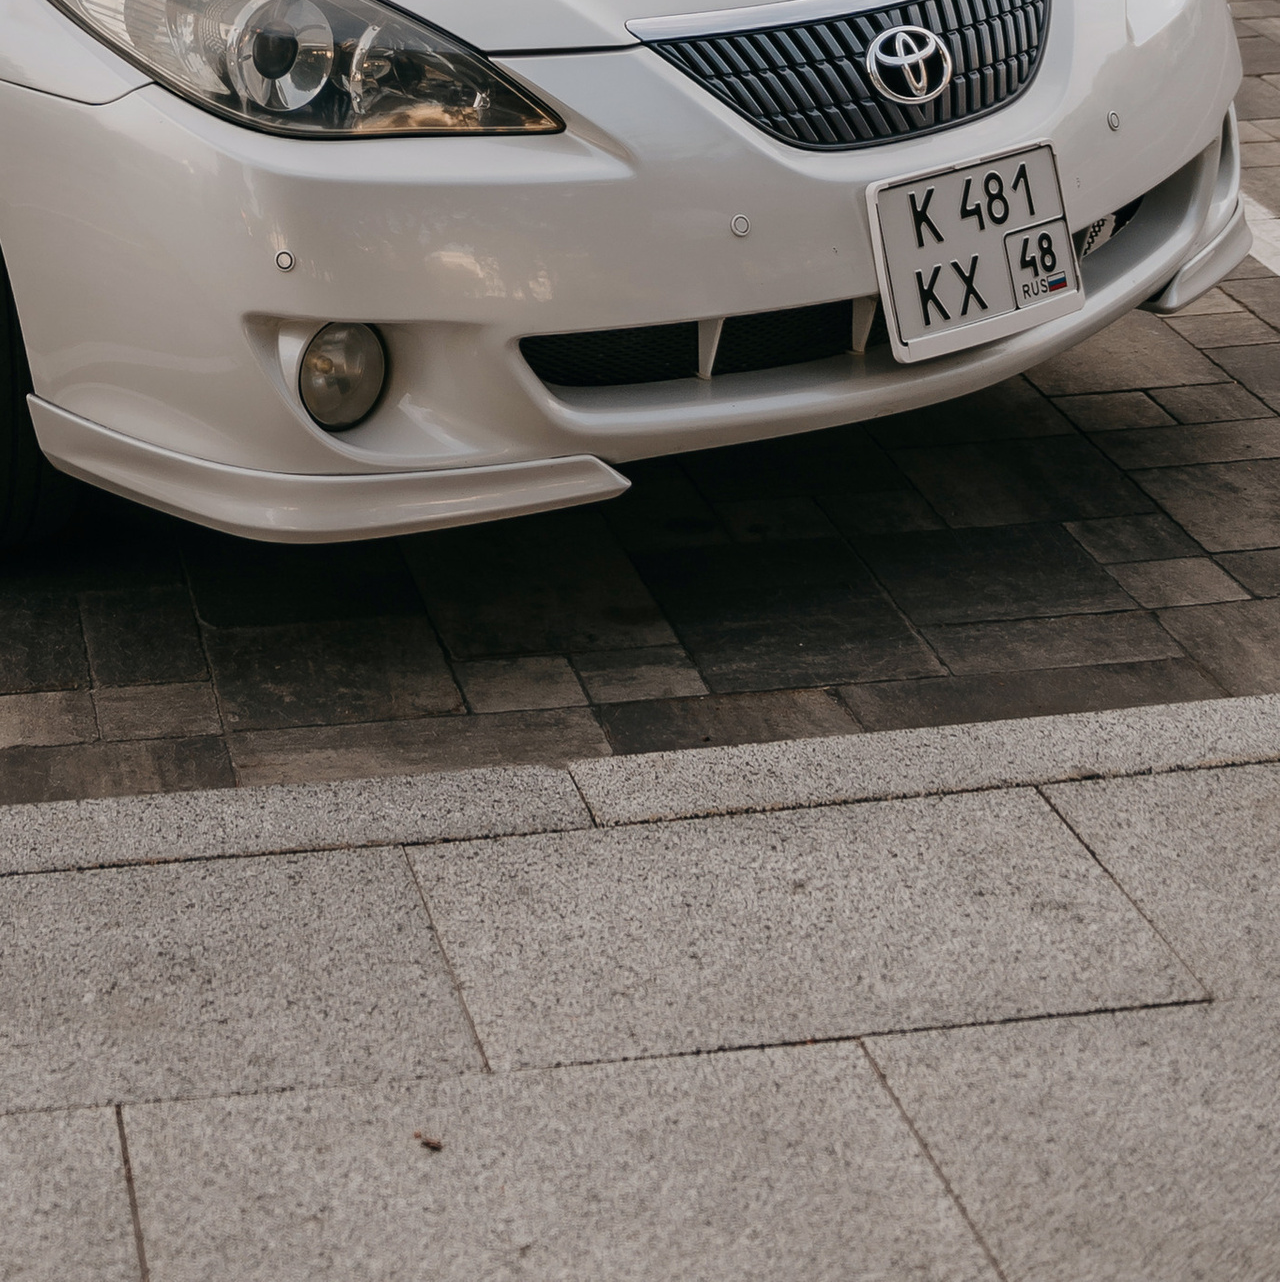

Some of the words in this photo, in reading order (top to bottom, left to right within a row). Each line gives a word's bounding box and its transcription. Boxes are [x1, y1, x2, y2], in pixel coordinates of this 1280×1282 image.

[960, 162, 1036, 231] 481
[1020, 232, 1057, 277] 48
[1022, 278, 1049, 299] RUS
